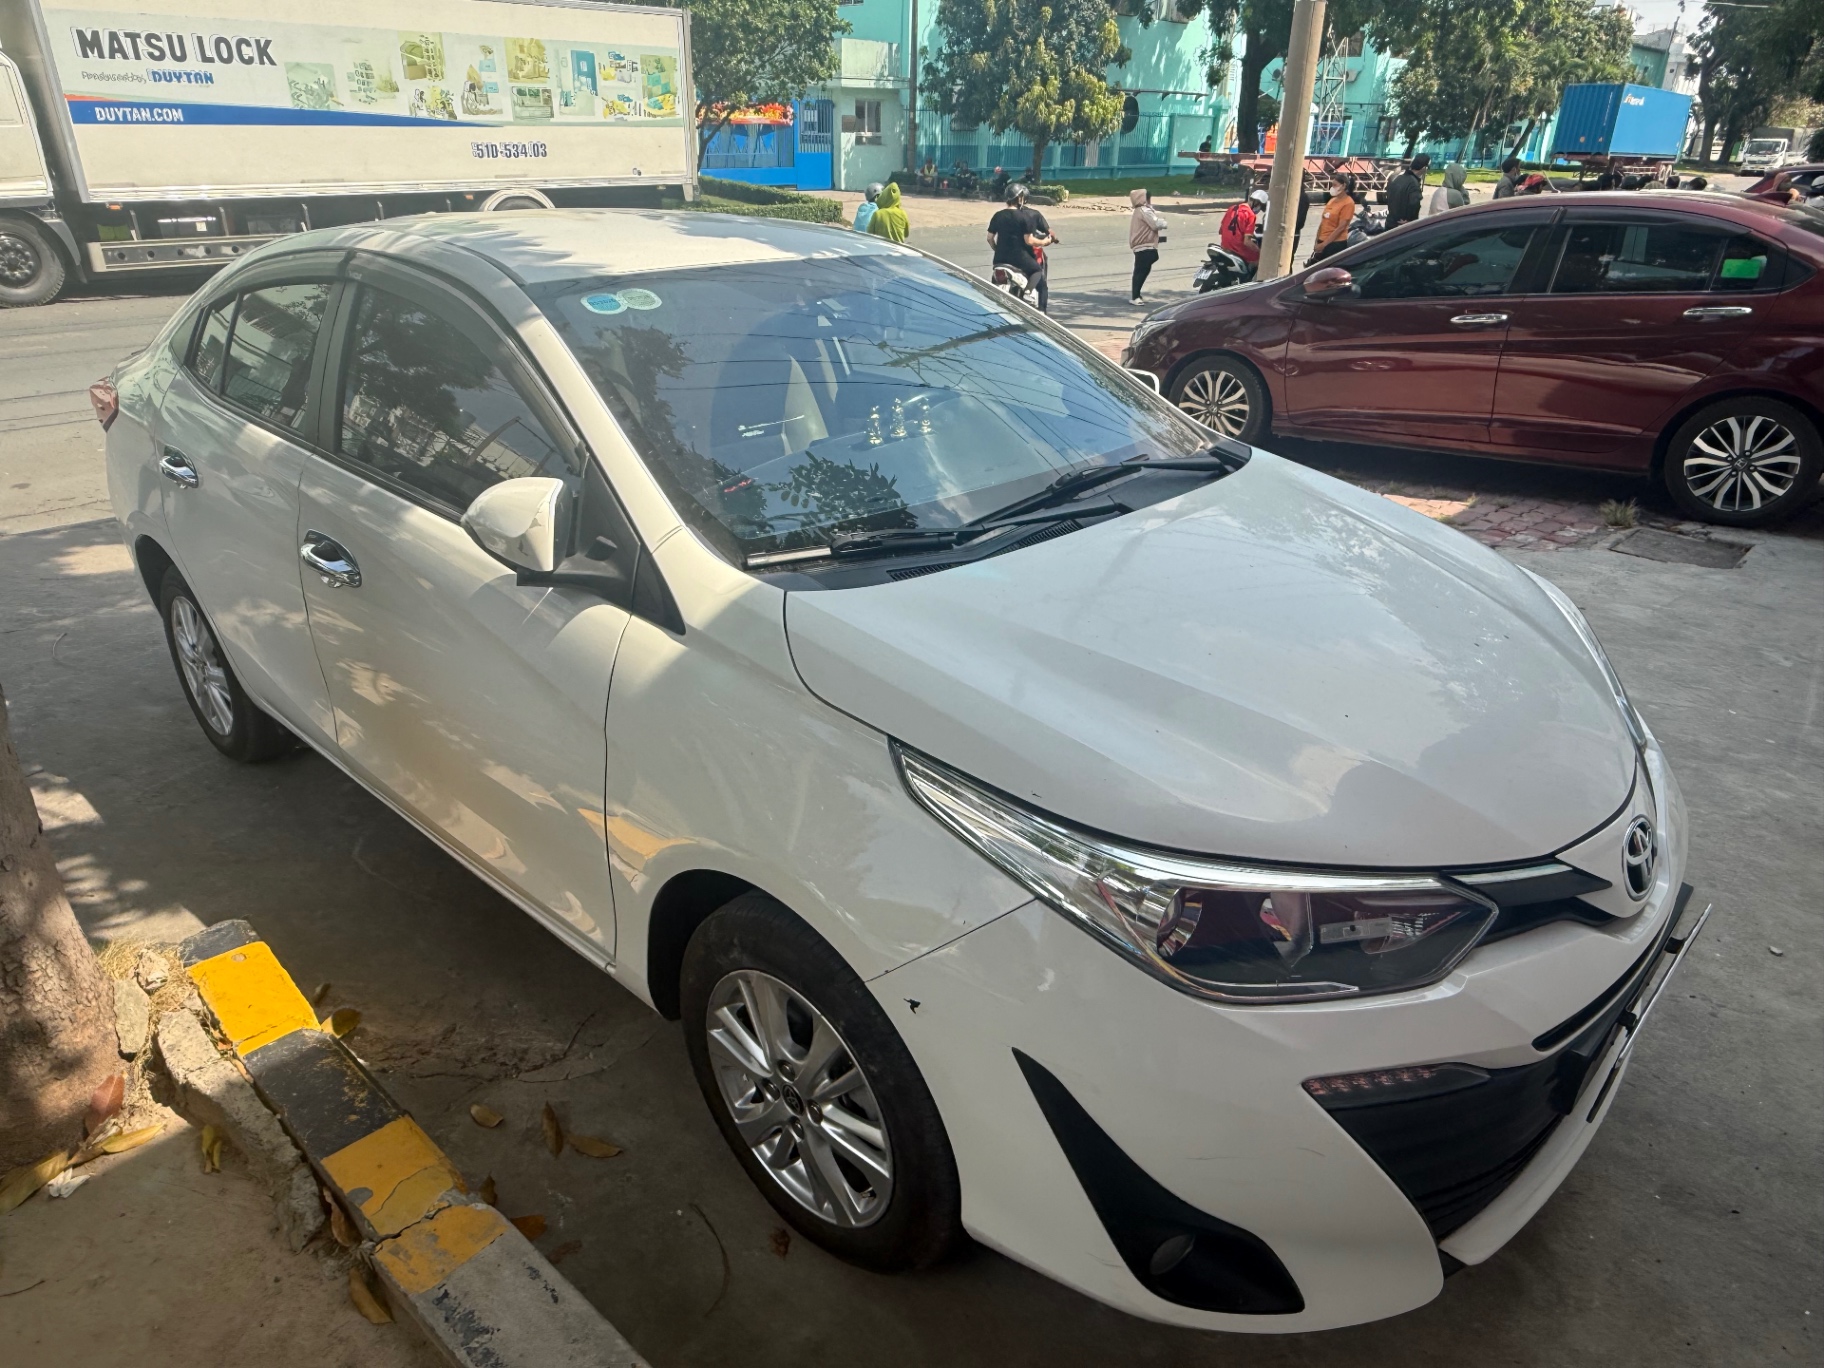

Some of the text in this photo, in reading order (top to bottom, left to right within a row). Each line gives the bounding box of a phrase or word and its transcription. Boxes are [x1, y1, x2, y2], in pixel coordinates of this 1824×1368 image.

[74, 28, 278, 66] MATSU LOCK
[94, 106, 184, 122] DUYTAN.COM
[475, 142, 548, 159] 51D-534.03
